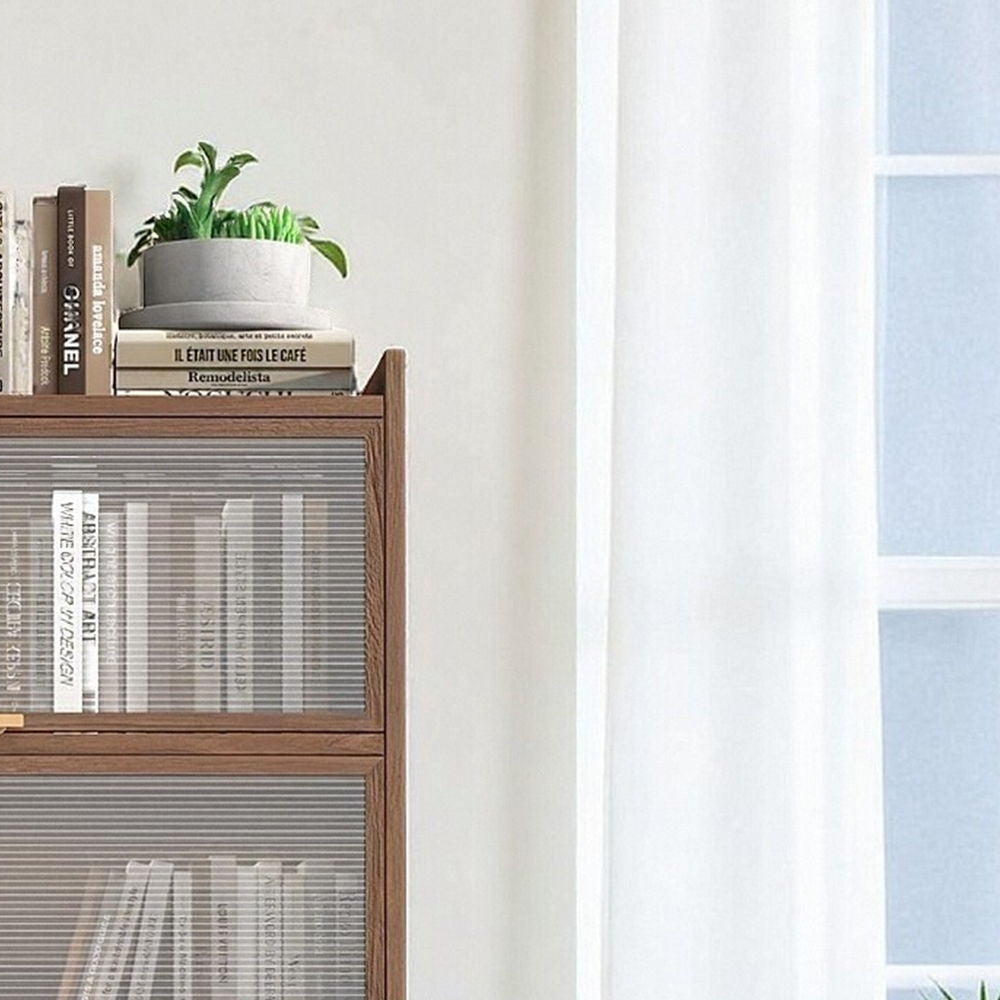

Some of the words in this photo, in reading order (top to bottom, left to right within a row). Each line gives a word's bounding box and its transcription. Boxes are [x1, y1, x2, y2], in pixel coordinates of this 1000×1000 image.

[67, 257, 74, 267] OF
[92, 245, 106, 297] amanda
[63, 285, 80, 375] CHANEL
[92, 300, 106, 355] lovelace
[174, 348, 184, 362] IL
[187, 346, 215, 362] ÉTAIT
[217, 348, 238, 362] UNE
[241, 348, 263, 362] FOIS
[265, 348, 278, 362] LE
[280, 346, 307, 362] CAFÉ
[188, 371, 271, 383] Remodelista
[60, 502, 74, 549] WHITE
[82, 511, 96, 605] ABSTRACT
[82, 610, 96, 647] ART
[60, 627, 74, 687] DESIGN
